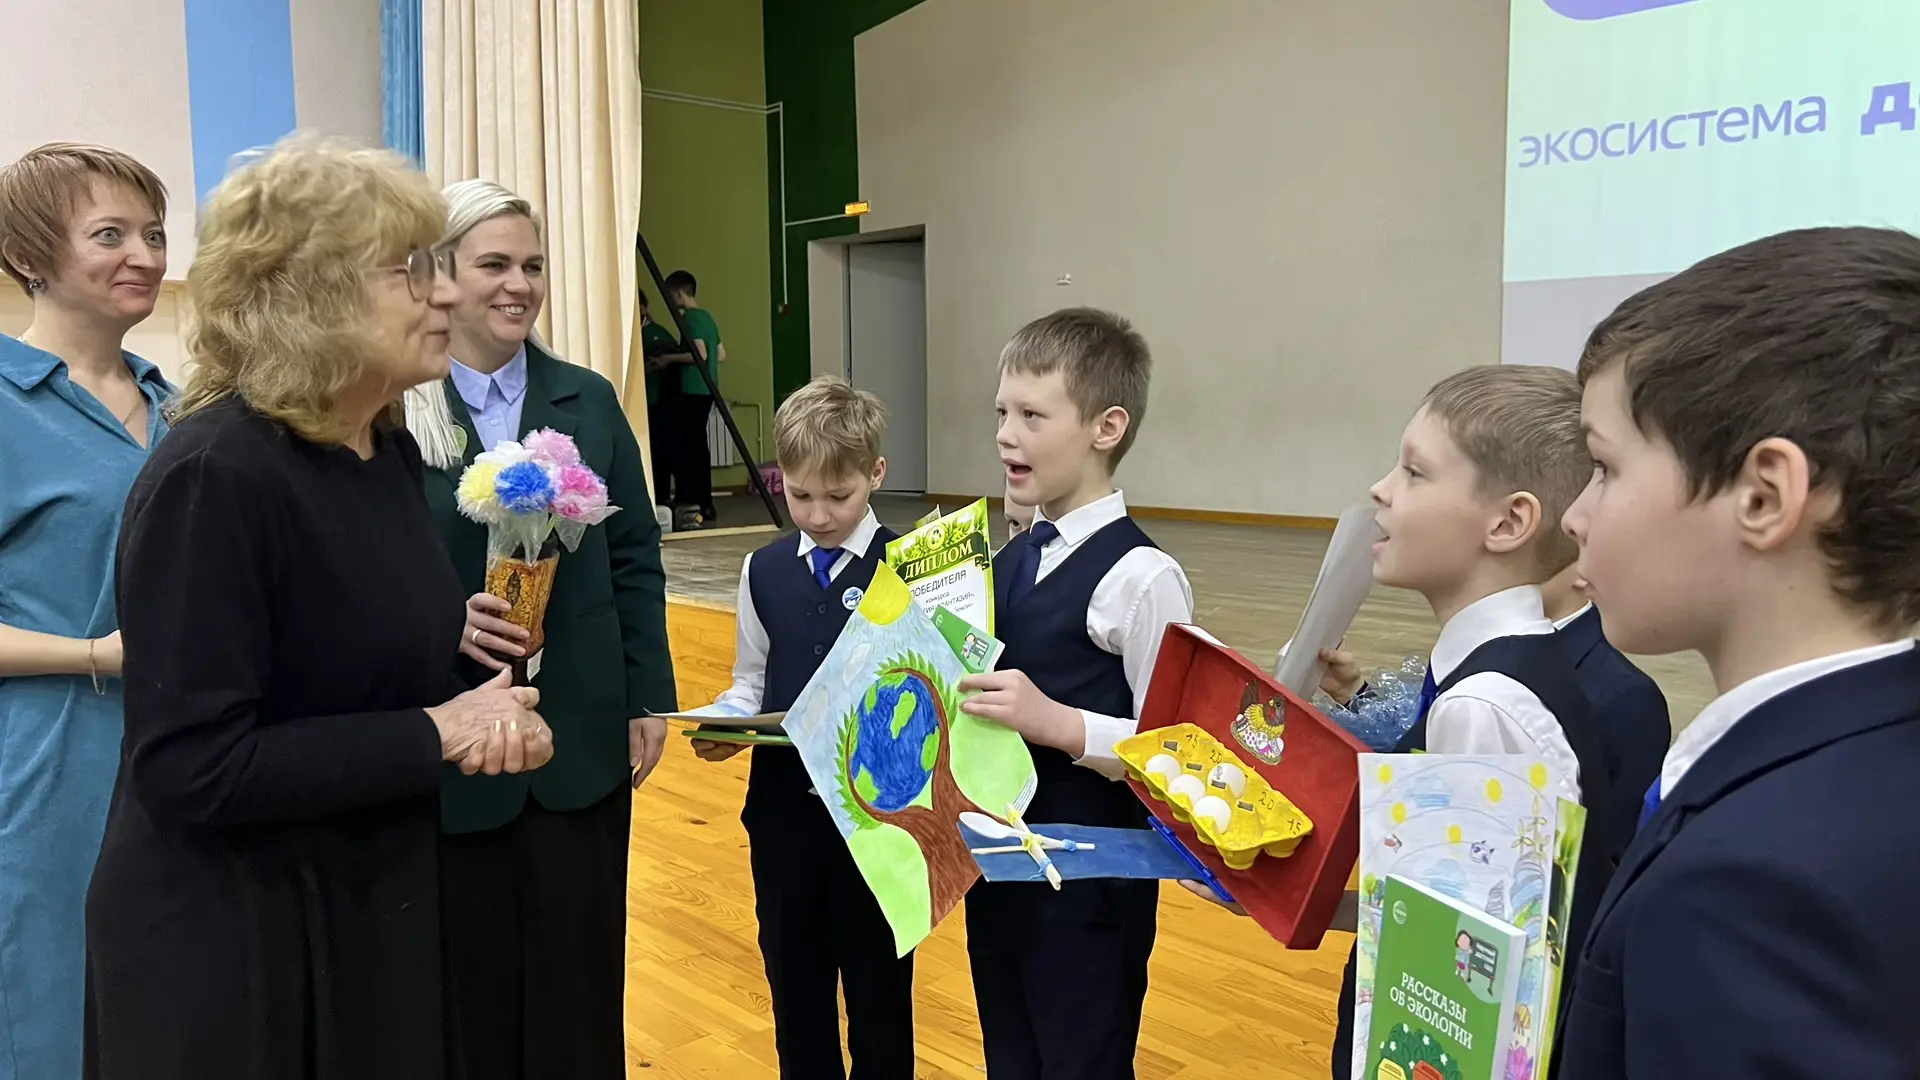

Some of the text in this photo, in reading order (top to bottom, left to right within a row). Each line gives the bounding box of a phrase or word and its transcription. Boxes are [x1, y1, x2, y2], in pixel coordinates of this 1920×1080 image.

[1518, 82, 1920, 168] экосистема д
[904, 539, 973, 580] ДИПЛОМ
[1258, 791, 1275, 810] 20
[1389, 986, 1473, 1049] ОБ ЭКОЛОГИИ
[1401, 971, 1467, 1023] РАССКАЗЫ
